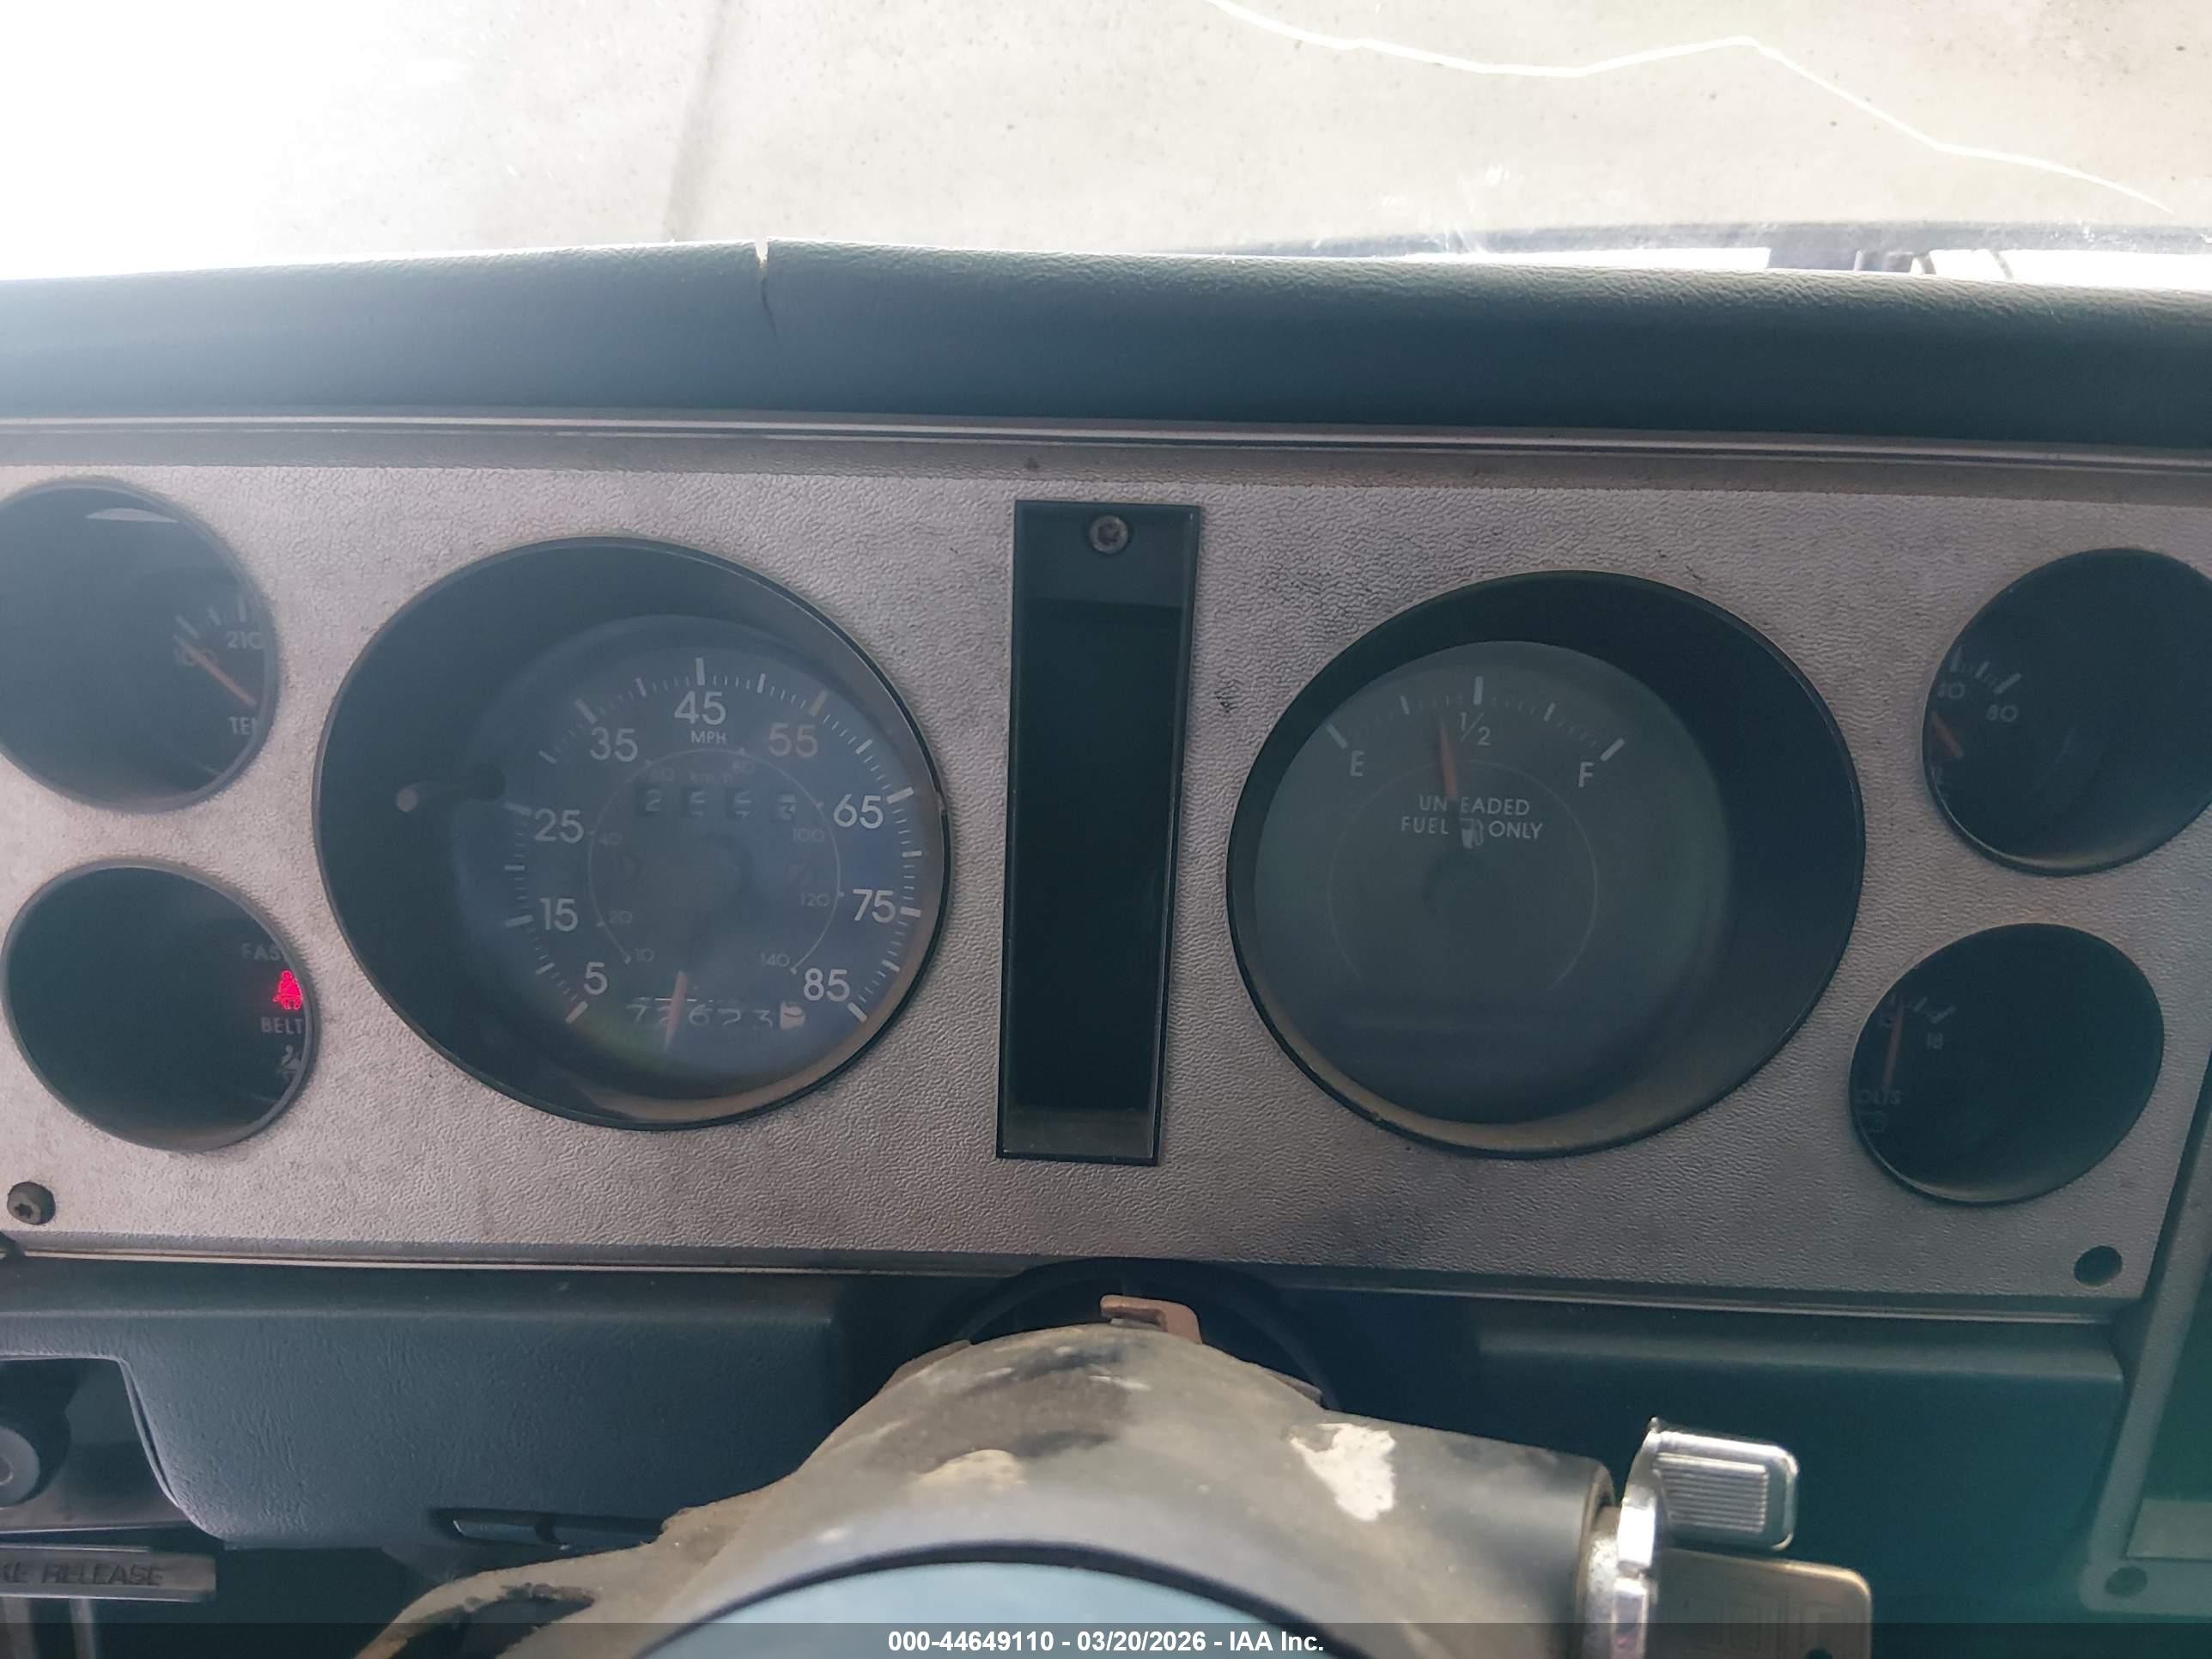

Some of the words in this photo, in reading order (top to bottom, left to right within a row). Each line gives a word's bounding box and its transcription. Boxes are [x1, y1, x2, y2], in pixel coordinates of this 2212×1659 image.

[673, 690, 727, 725] 45
[1986, 704, 2019, 722] 80
[590, 727, 638, 763] 35
[690, 729, 727, 744] MPH
[769, 723, 818, 757] 55
[1350, 752, 1366, 777] E
[1578, 761, 1595, 787] F
[833, 793, 884, 829] 65
[1419, 793, 1531, 817] UNEADED
[534, 808, 584, 843] 25
[1401, 817, 1449, 836] FUEL
[1489, 819, 1544, 841] ONLY
[538, 897, 579, 933] 15
[852, 888, 896, 921] 75
[583, 962, 608, 994] 5
[803, 968, 851, 1001] 85
[41, 1563, 163, 1586] RELEASE
